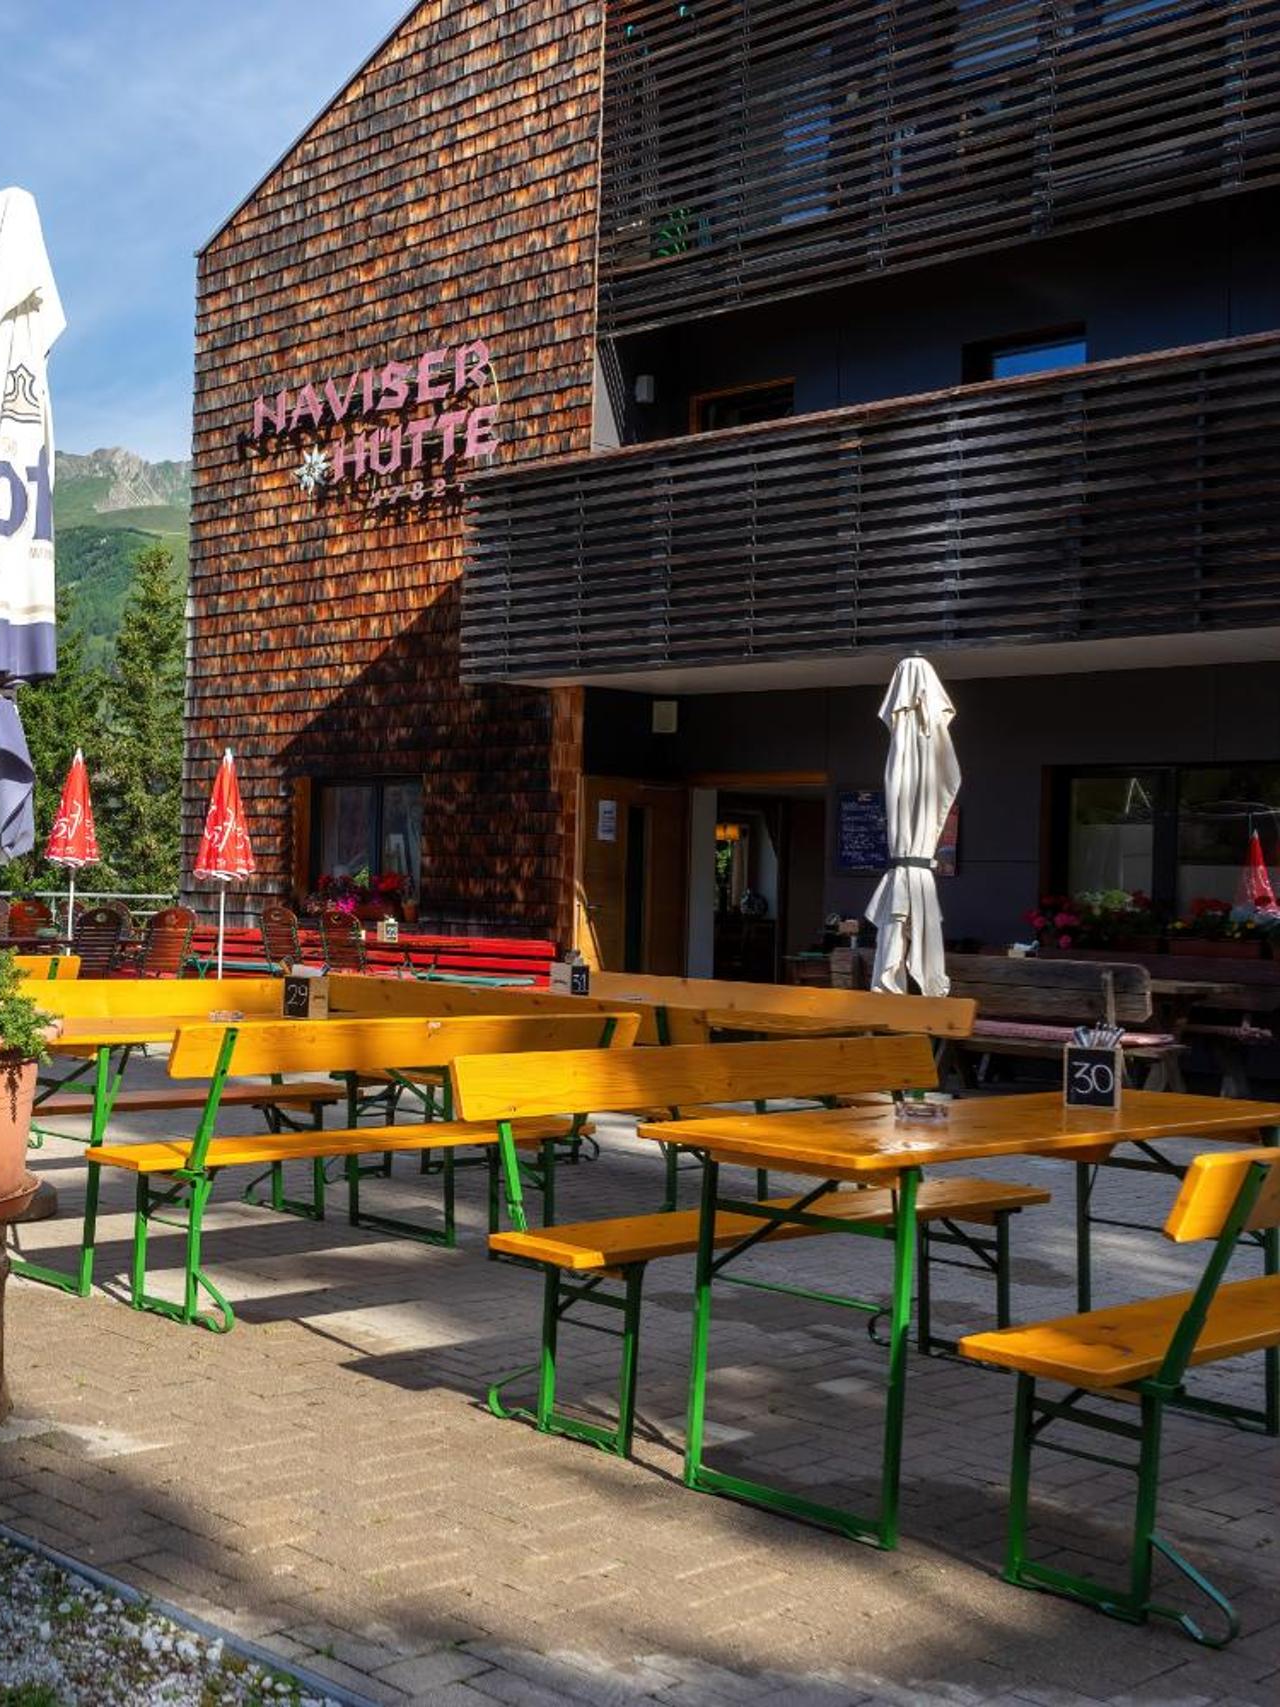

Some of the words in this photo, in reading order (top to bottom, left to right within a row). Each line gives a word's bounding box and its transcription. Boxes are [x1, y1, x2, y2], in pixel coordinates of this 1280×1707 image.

[253, 339, 490, 438] NAVISER
[331, 404, 500, 484] HÜTTE
[286, 984, 308, 1007] 29
[1071, 1061, 1114, 1094] 30
